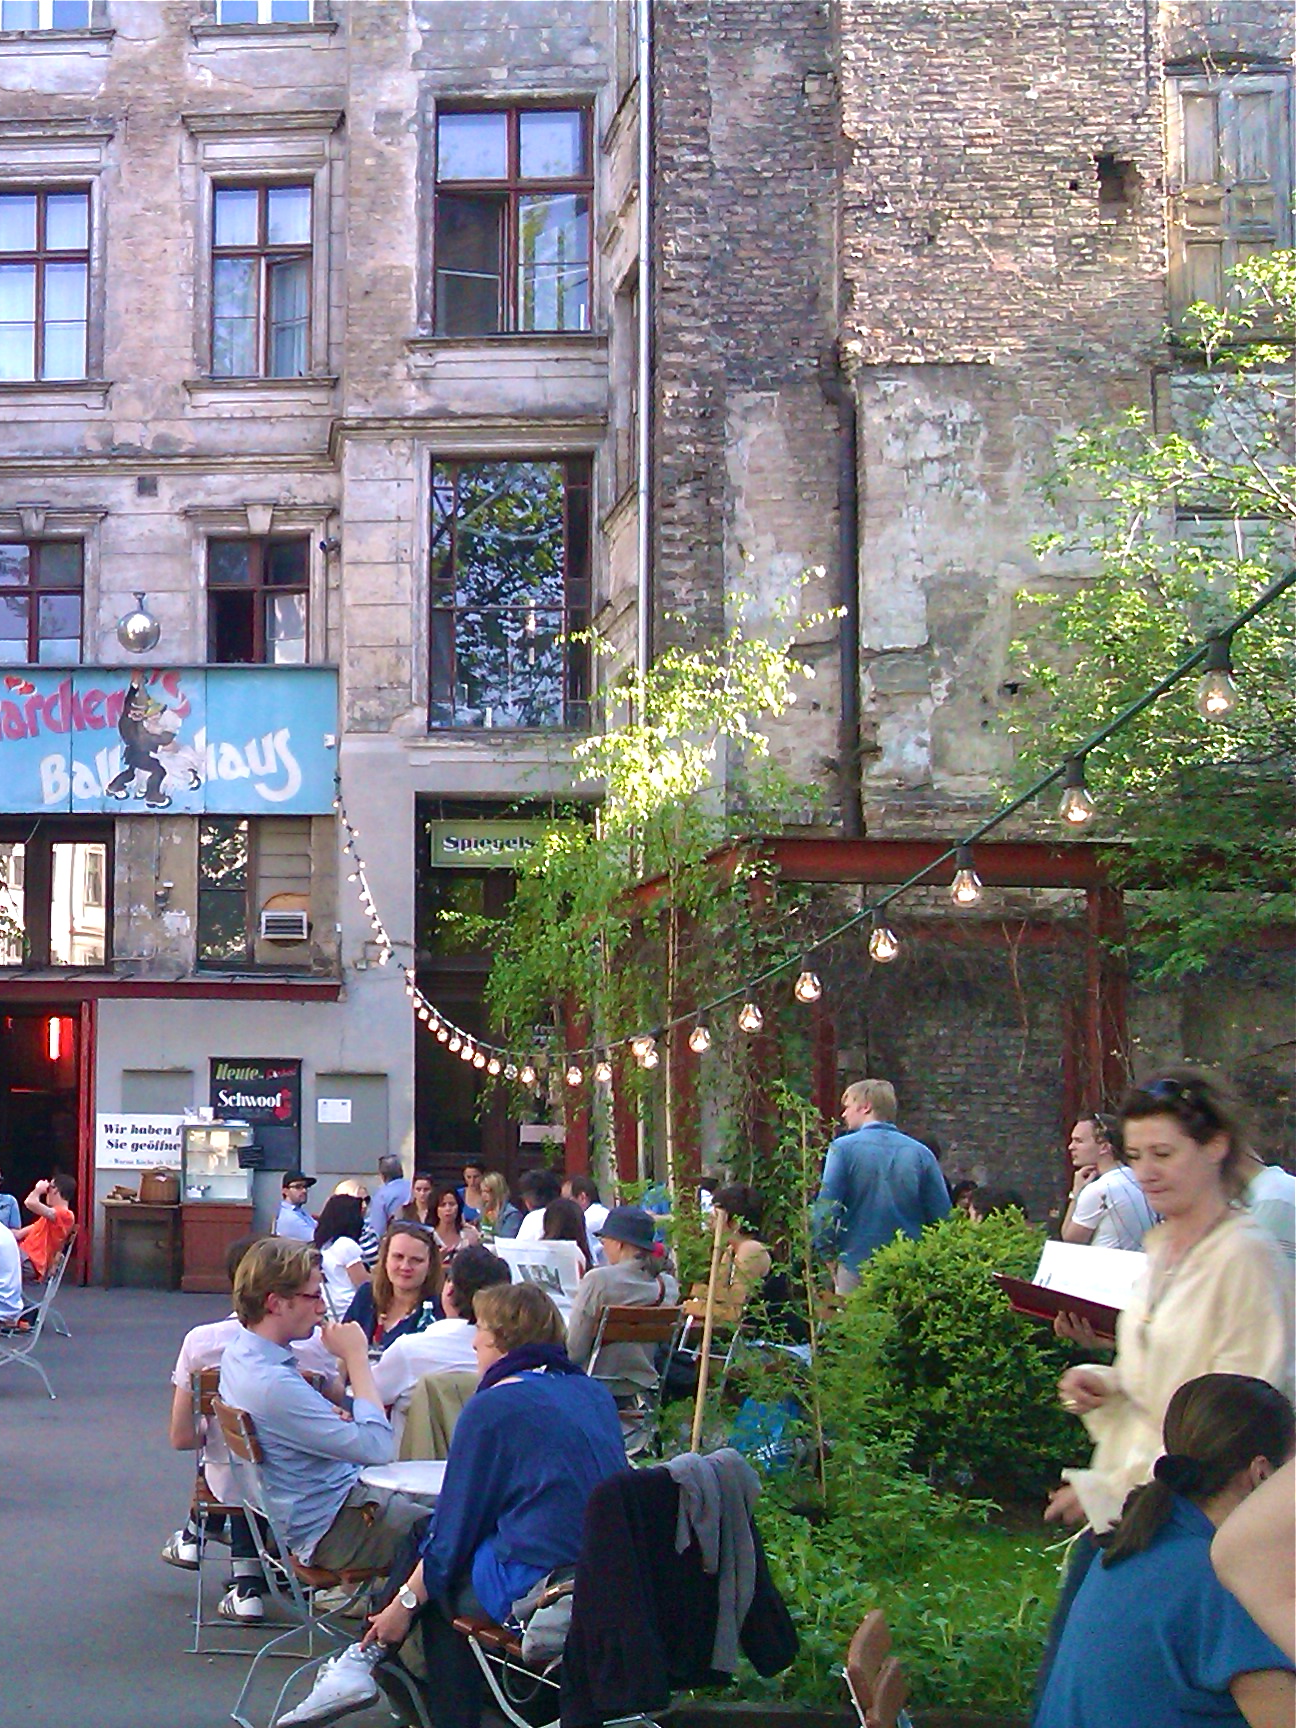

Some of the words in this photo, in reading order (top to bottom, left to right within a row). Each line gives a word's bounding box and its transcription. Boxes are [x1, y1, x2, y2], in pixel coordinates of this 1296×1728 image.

[443, 836, 536, 854] Spiegels
[218, 1089, 282, 1107] Schwoof
[104, 1124, 127, 1135] Wir
[130, 1124, 172, 1135] haben
[106, 1139, 127, 1150] Sie
[131, 1139, 181, 1152] geöffne
